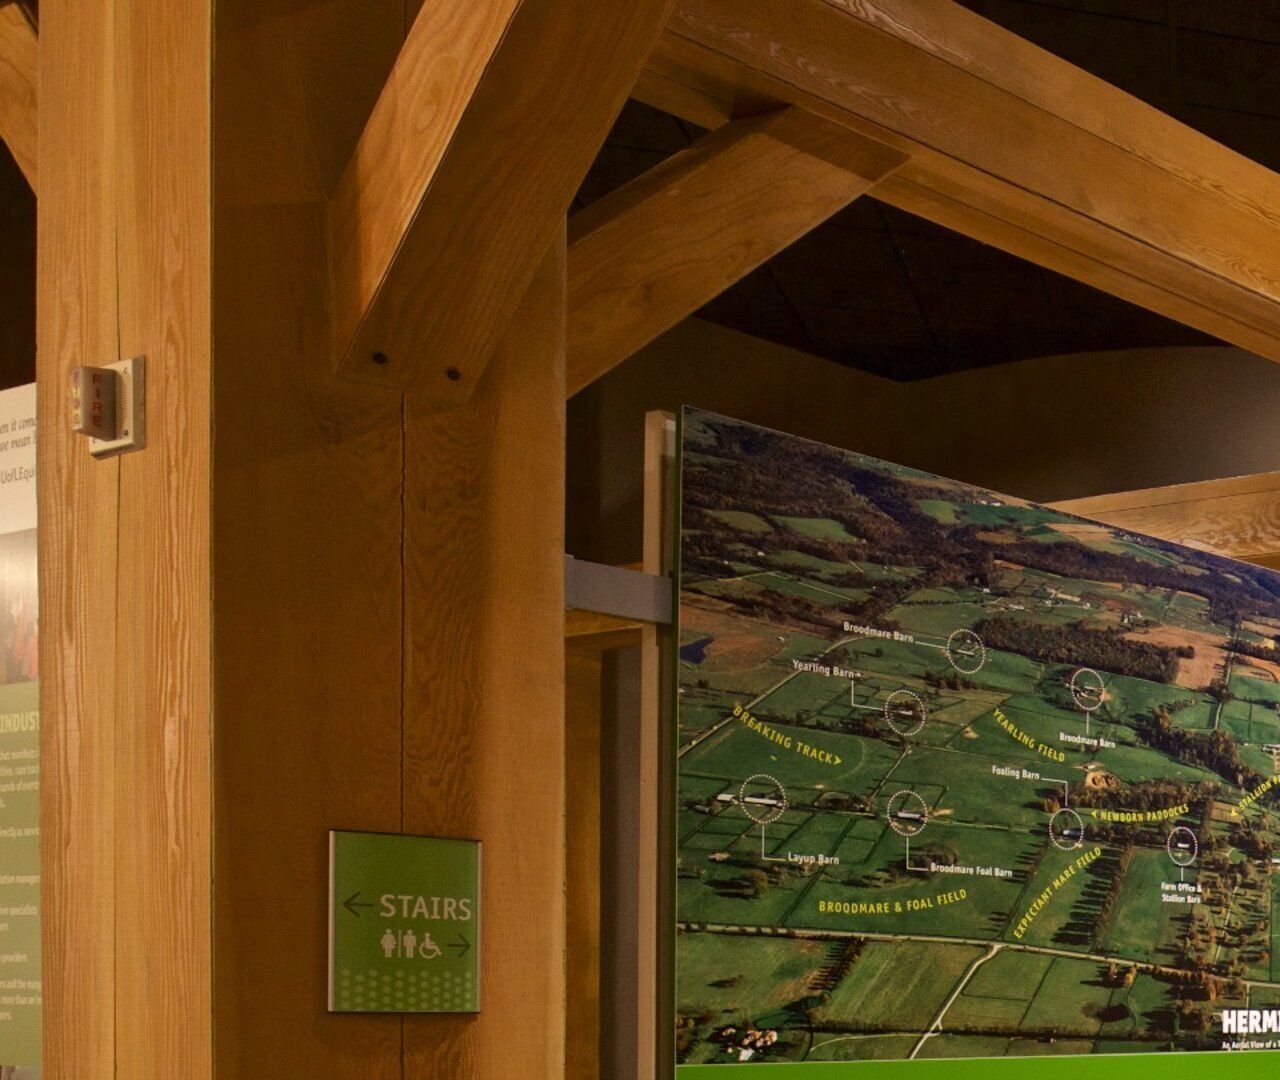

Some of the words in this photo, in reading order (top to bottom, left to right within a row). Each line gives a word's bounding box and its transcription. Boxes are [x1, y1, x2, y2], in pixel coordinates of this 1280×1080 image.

[843, 621, 891, 639] Broodmare
[893, 631, 914, 643] Barn
[792, 659, 830, 676] Yearling
[832, 665, 854, 677] Barn
[733, 705, 792, 748] BREAKING
[796, 742, 834, 764] TRACK
[993, 708, 1036, 749] YEARLING
[1038, 744, 1065, 762] FIELD
[1059, 732, 1098, 746] Broodmare
[992, 765, 1020, 780] Foaling
[1022, 769, 1040, 780] Barn
[1239, 780, 1272, 811] STALLION
[1100, 810, 1144, 823] NEWBORN
[1147, 803, 1190, 822] PADDOCKS
[787, 852, 815, 865] Layup
[818, 854, 840, 865] Barn
[930, 863, 974, 875] Broodmare
[976, 866, 992, 876] Foal
[994, 868, 1013, 877] Barn
[1013, 886, 1053, 940] EXPECTANT
[1052, 865, 1077, 890] MARE
[1076, 847, 1102, 869] FIELD
[1161, 881, 1176, 891] Farm
[1178, 883, 1196, 893] Office
[379, 893, 472, 921] STAIRS
[818, 901, 889, 914] BROODMARE
[894, 903, 902, 913] &
[907, 897, 933, 911] FOAL
[936, 888, 967, 905] FIELD
[1162, 893, 1185, 903] Stallion
[1187, 894, 1201, 903] Barn
[1232, 1040, 1249, 1049] Aerial
[1250, 1040, 1264, 1048] View
[1265, 1040, 1272, 1048] of
